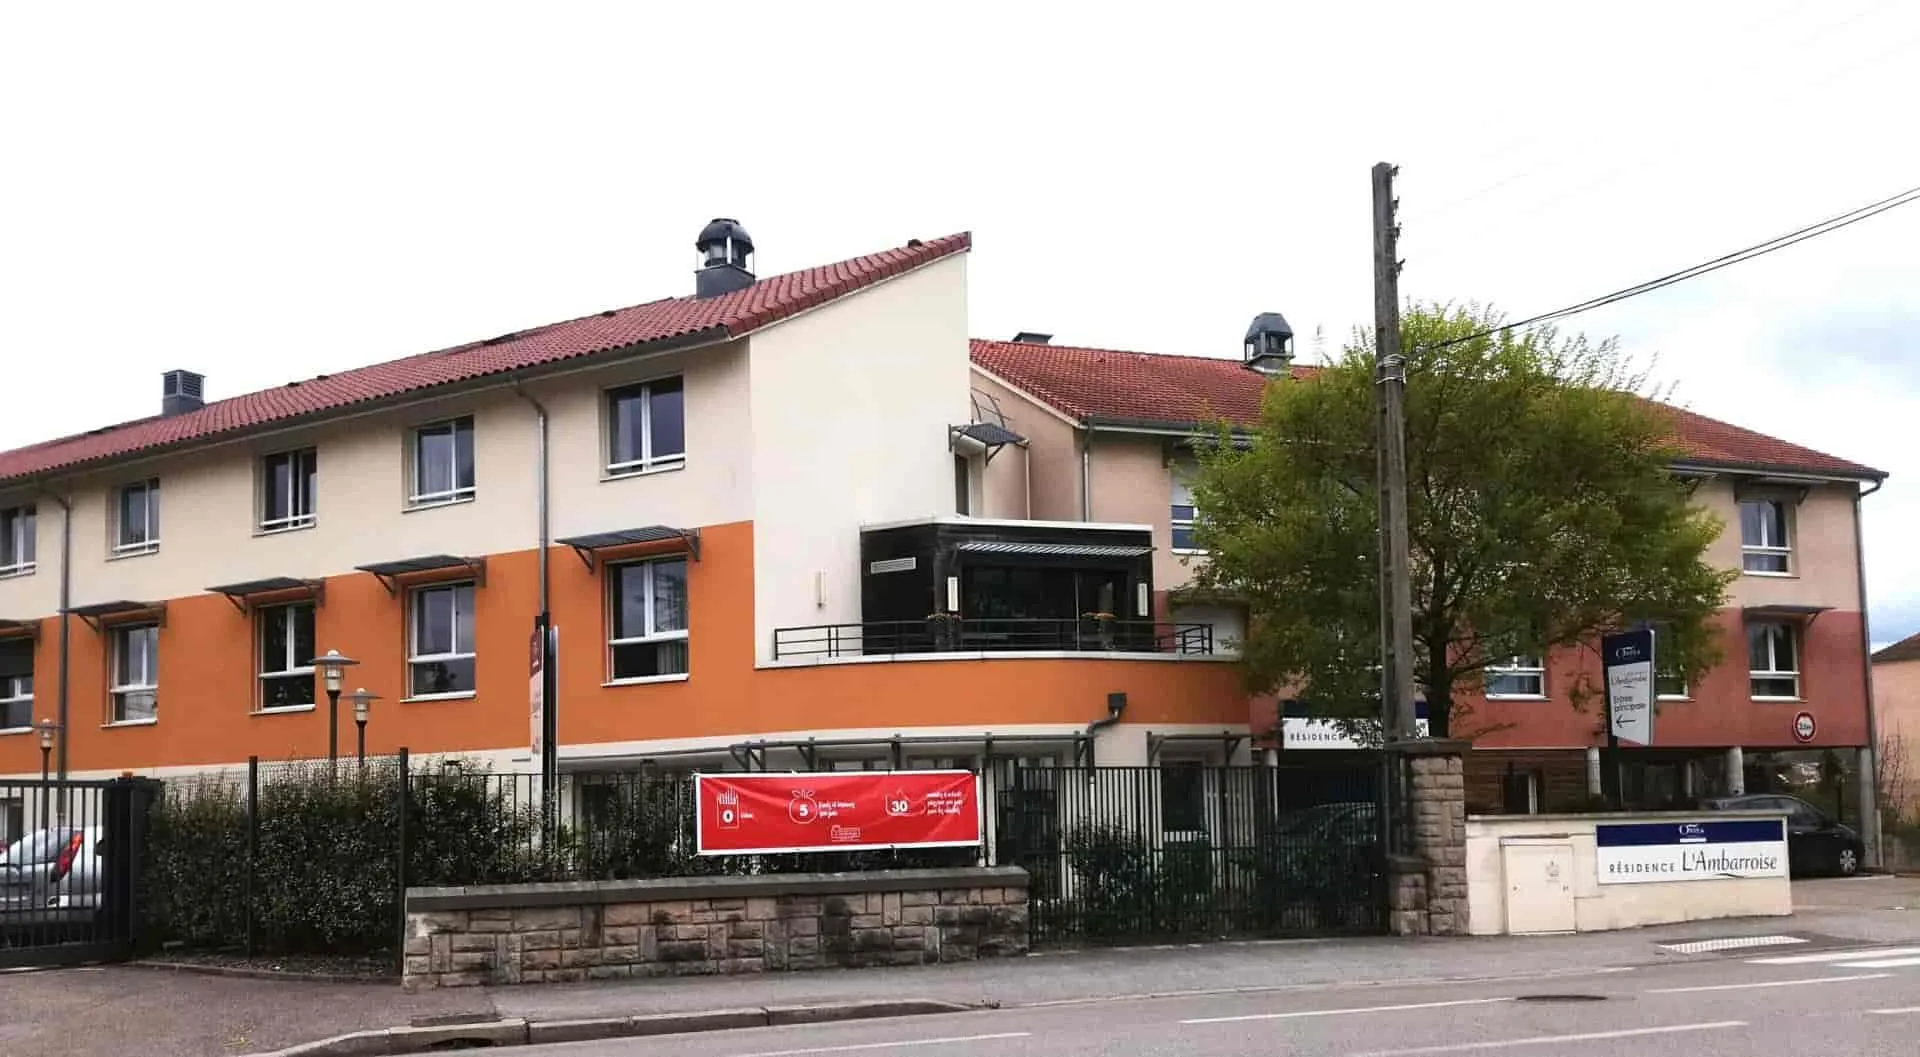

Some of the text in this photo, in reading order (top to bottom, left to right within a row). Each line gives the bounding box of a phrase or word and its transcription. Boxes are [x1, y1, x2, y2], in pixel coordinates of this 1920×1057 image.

[799, 803, 809, 817] 5
[891, 799, 908, 813] 30
[722, 809, 734, 824] 0
[1609, 848, 1777, 873] RÉSIDENCE L'Ambarroise
